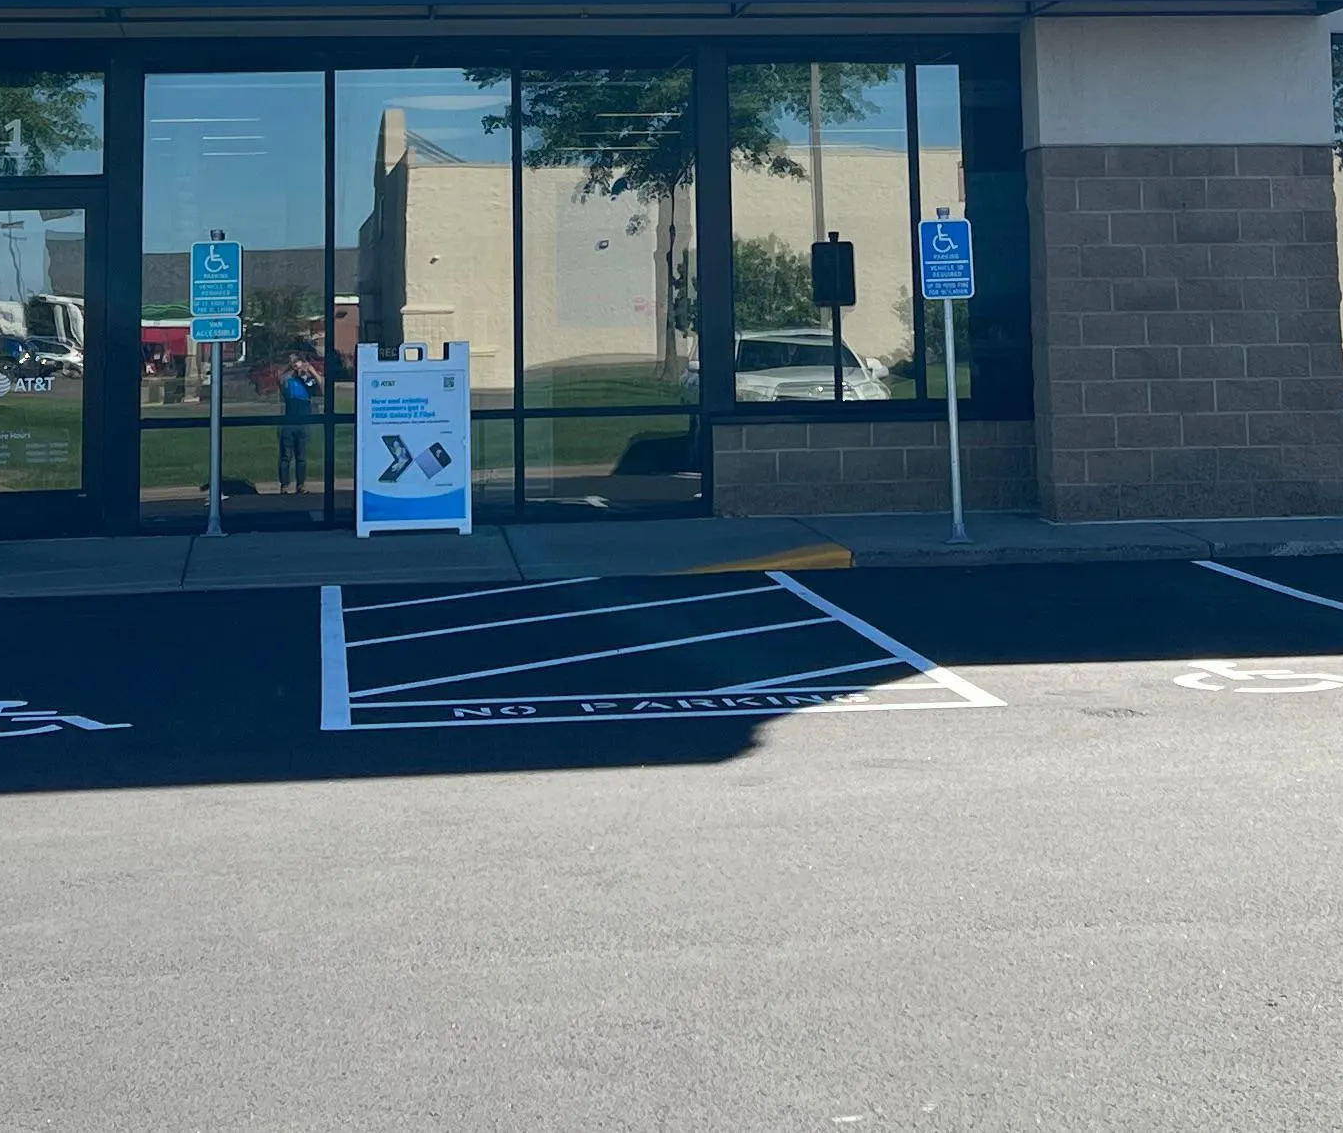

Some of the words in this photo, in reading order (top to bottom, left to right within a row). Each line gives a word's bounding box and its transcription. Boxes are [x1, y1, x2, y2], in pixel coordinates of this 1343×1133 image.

[14, 377, 56, 392] AT&T
[453, 704, 537, 719] NO
[579, 692, 870, 713] PARKING
